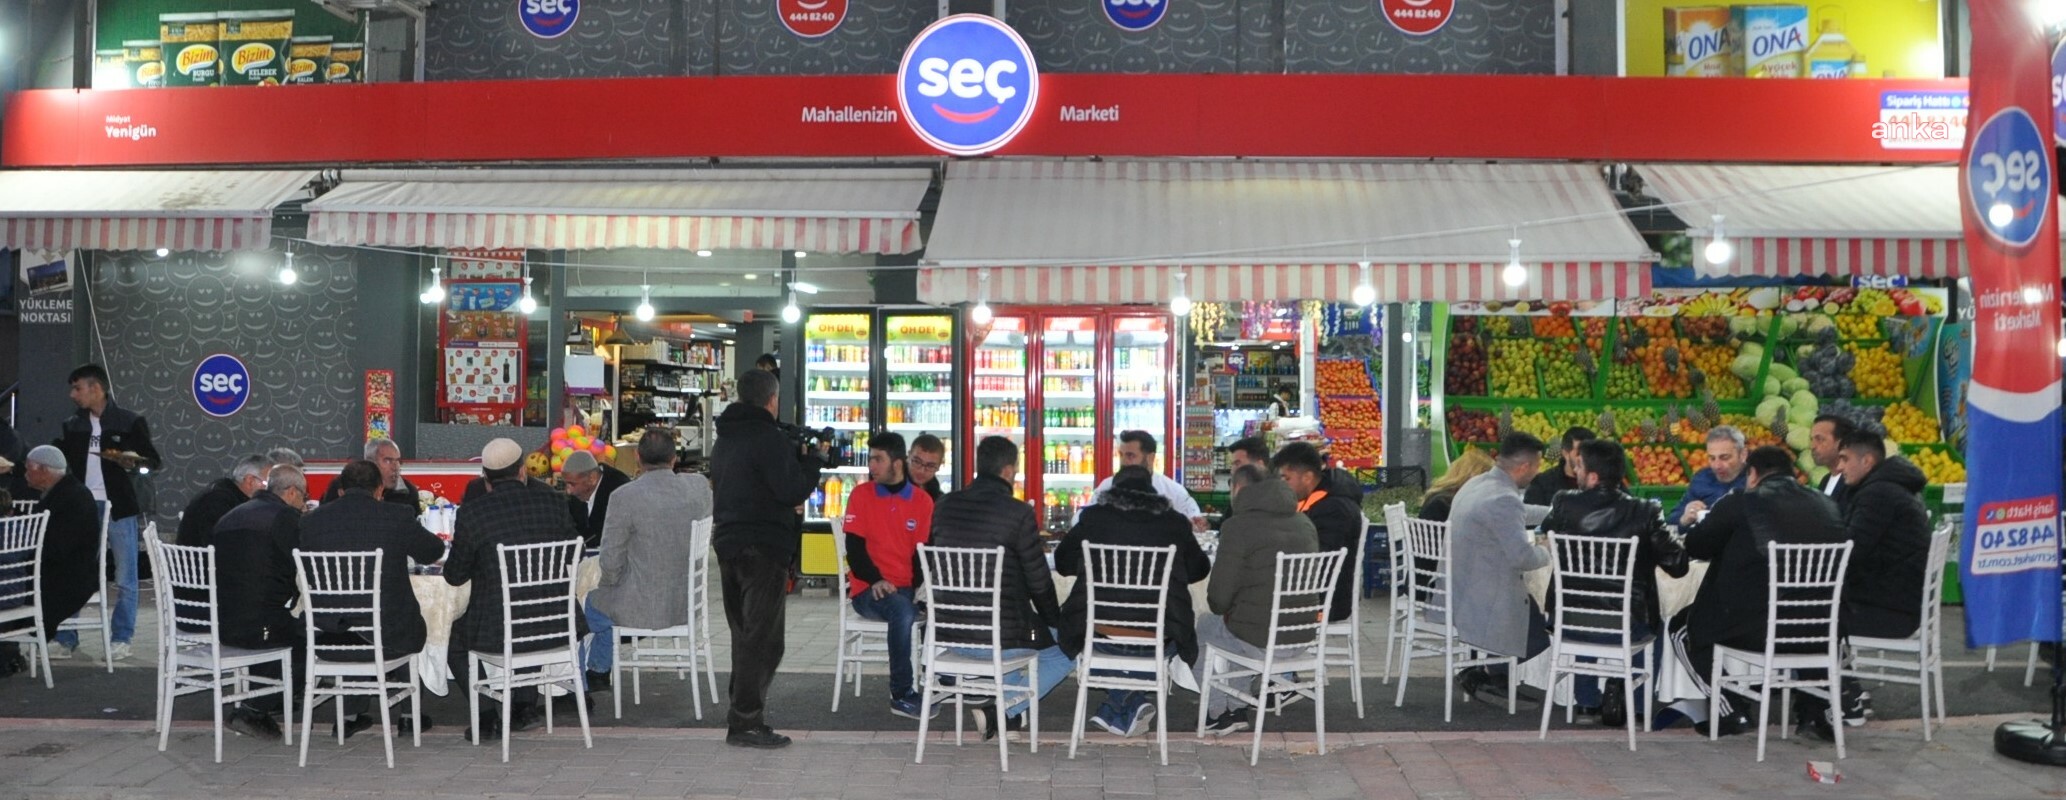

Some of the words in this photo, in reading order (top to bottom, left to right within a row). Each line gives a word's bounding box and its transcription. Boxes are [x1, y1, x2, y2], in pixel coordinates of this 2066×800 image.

[789, 12, 809, 22] 444
[1393, 8, 1414, 18] 444
[1688, 27, 1731, 60] ONA
[1752, 26, 1804, 57] ONA
[182, 50, 214, 66] Bizim
[237, 47, 271, 66] Bizim
[248, 68, 277, 77] KELEBEK
[917, 56, 1018, 104] seç
[800, 106, 898, 124] Mahallenizin
[1059, 105, 1120, 122] Marketi
[105, 124, 157, 141] Yenigün
[19, 297, 73, 310] YÜKLEME
[20, 312, 71, 323] NOKTASI
[199, 373, 243, 395] seç
